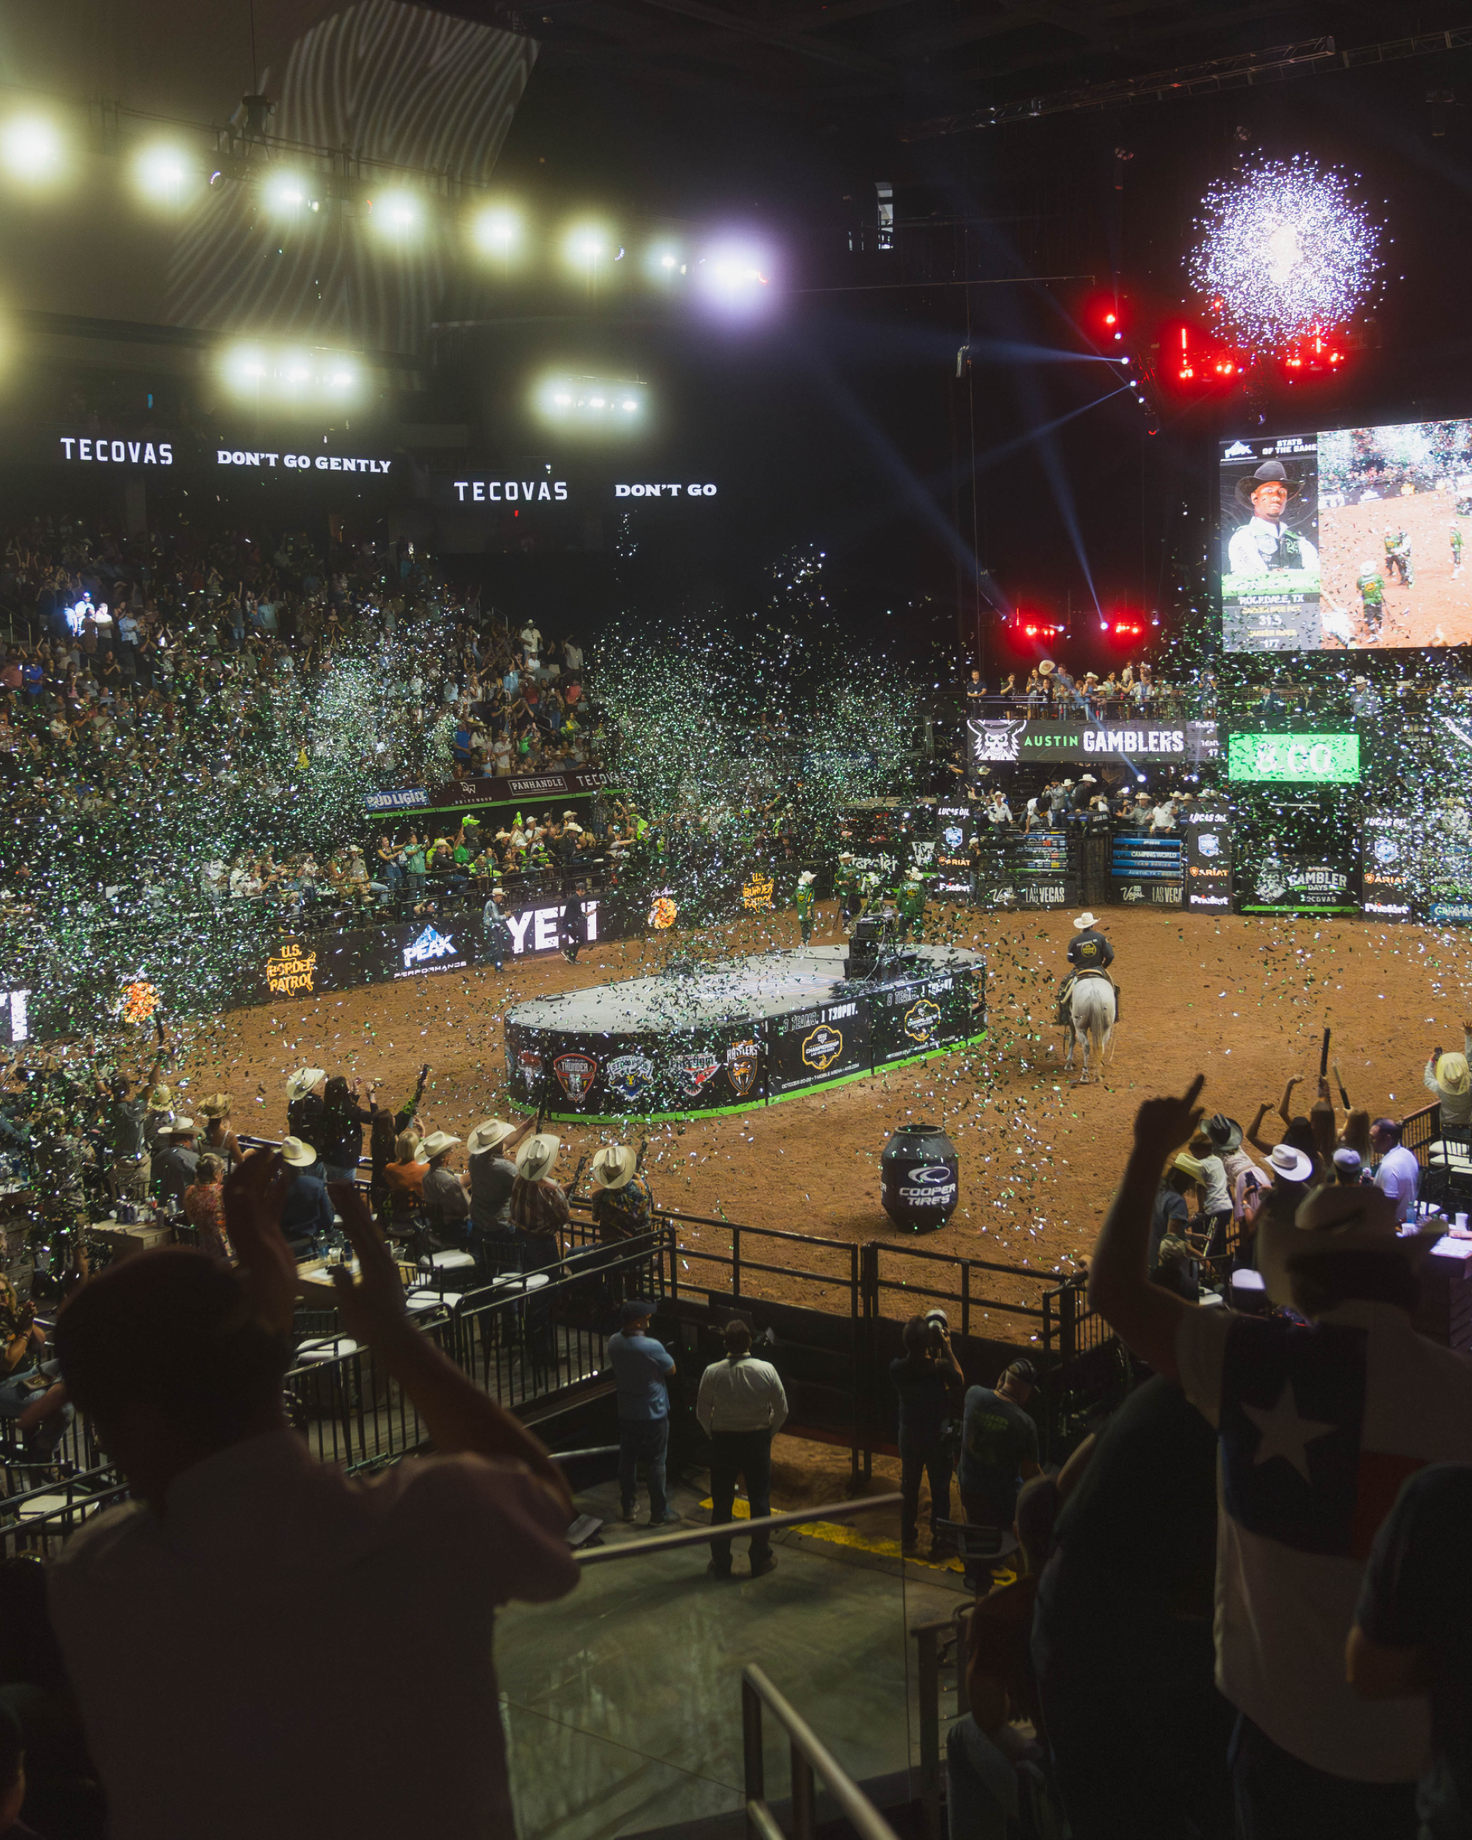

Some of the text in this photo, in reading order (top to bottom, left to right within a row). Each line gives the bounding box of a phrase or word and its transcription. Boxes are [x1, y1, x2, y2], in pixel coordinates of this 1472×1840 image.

[60, 437, 173, 465] TECOVAS
[217, 450, 392, 473] DON'T GO GENTLY
[453, 481, 568, 501] TECOVAS
[615, 483, 718, 497] DON'T GO
[1292, 594, 1304, 603] TX
[1024, 730, 1184, 752] AUSTIN GAMBLERS
[511, 778, 564, 791] PANHANDLE
[1199, 869, 1229, 877] ARIAT
[1289, 872, 1347, 887] GAMBLER
[1374, 876, 1407, 884] ARIAT
[1039, 887, 1065, 903] VEGAS
[1152, 887, 1164, 902] LAS
[1164, 887, 1183, 903] VEGA
[506, 901, 597, 954] YEI
[281, 944, 302, 958] U.S.
[403, 934, 458, 969] PEAK
[269, 973, 314, 992] PATROL
[828, 1002, 859, 1021] TROPHY.
[561, 1061, 588, 1072] THUNDER
[899, 1183, 956, 1196] COOPER
[907, 1194, 951, 1206] TIRES
